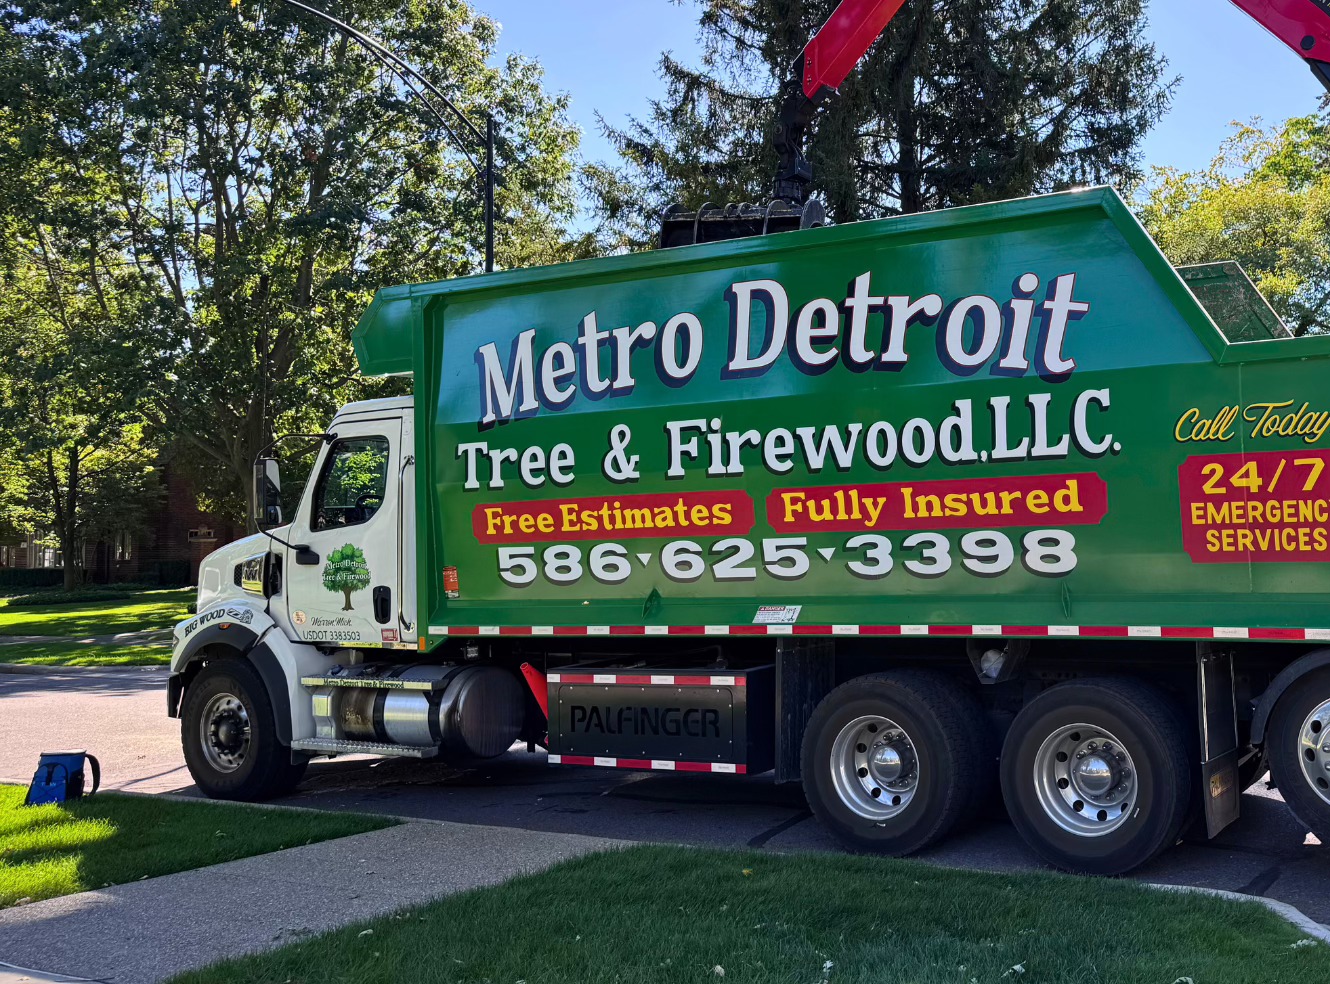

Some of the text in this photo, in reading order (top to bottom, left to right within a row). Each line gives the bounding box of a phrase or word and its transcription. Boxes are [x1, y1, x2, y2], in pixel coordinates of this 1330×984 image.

[477, 271, 1090, 430] Metro Detroit
[1174, 404, 1240, 443] Call
[457, 441, 576, 490] Tree
[602, 423, 641, 483] &
[1201, 457, 1326, 495] 24/7
[484, 497, 733, 536] Free Estimates
[781, 479, 1084, 527] Fully Insured
[1205, 527, 1328, 553] SERVICES
[184, 608, 226, 638] BIG WOOD
[302, 630, 361, 641] USDOT 3383503
[570, 705, 720, 738] PALFINGER
